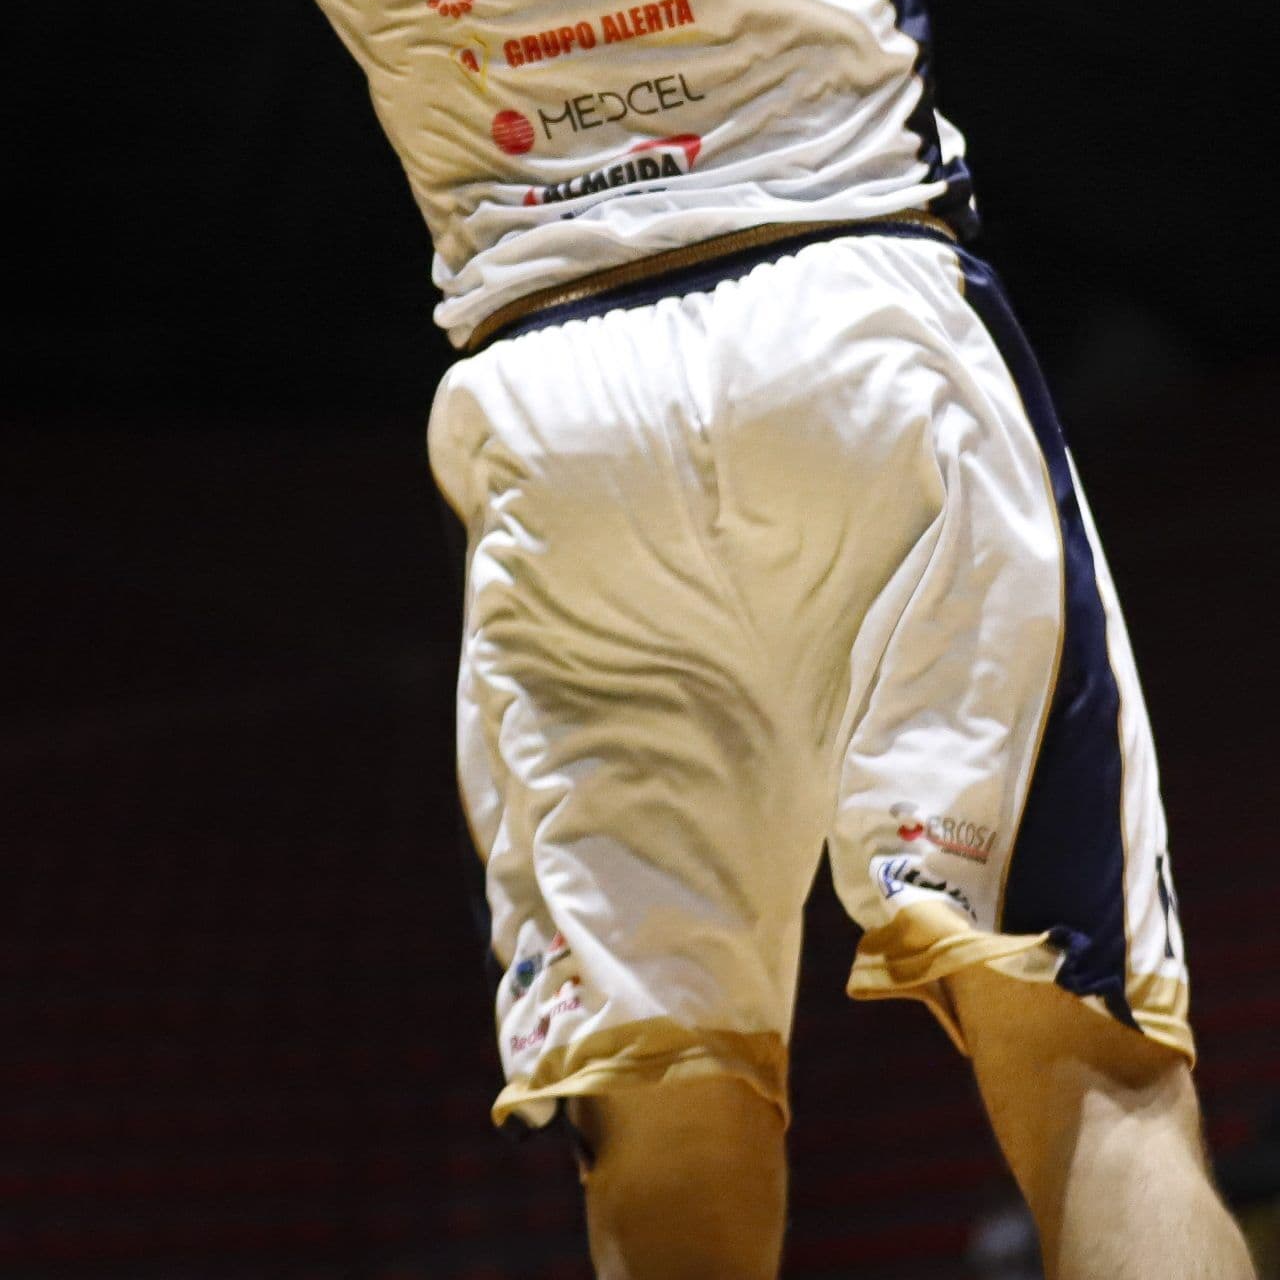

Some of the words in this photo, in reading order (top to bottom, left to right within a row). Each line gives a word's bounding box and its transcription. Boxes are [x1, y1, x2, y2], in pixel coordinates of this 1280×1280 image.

[503, 20, 597, 69] GRUPO
[537, 73, 705, 140] MEDCEL
[542, 153, 684, 204] ALMEIDA
